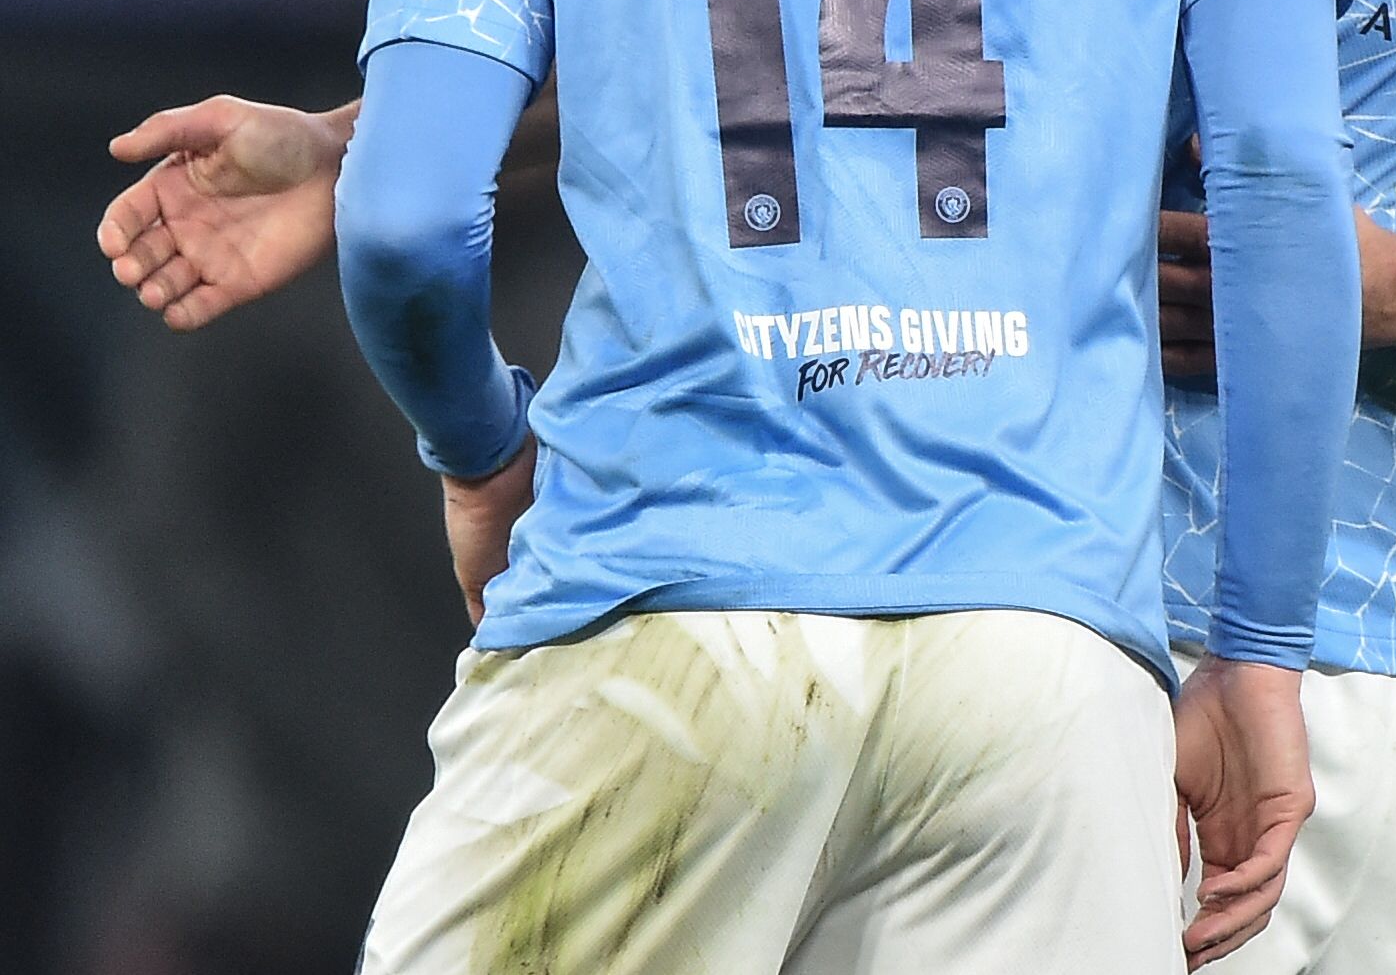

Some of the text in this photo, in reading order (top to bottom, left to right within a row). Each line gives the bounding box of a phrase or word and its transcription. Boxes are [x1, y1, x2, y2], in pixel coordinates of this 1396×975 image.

[733, 305, 1029, 360] CITYZENS GIVING
[797, 348, 996, 402] FOR RECOVERY
